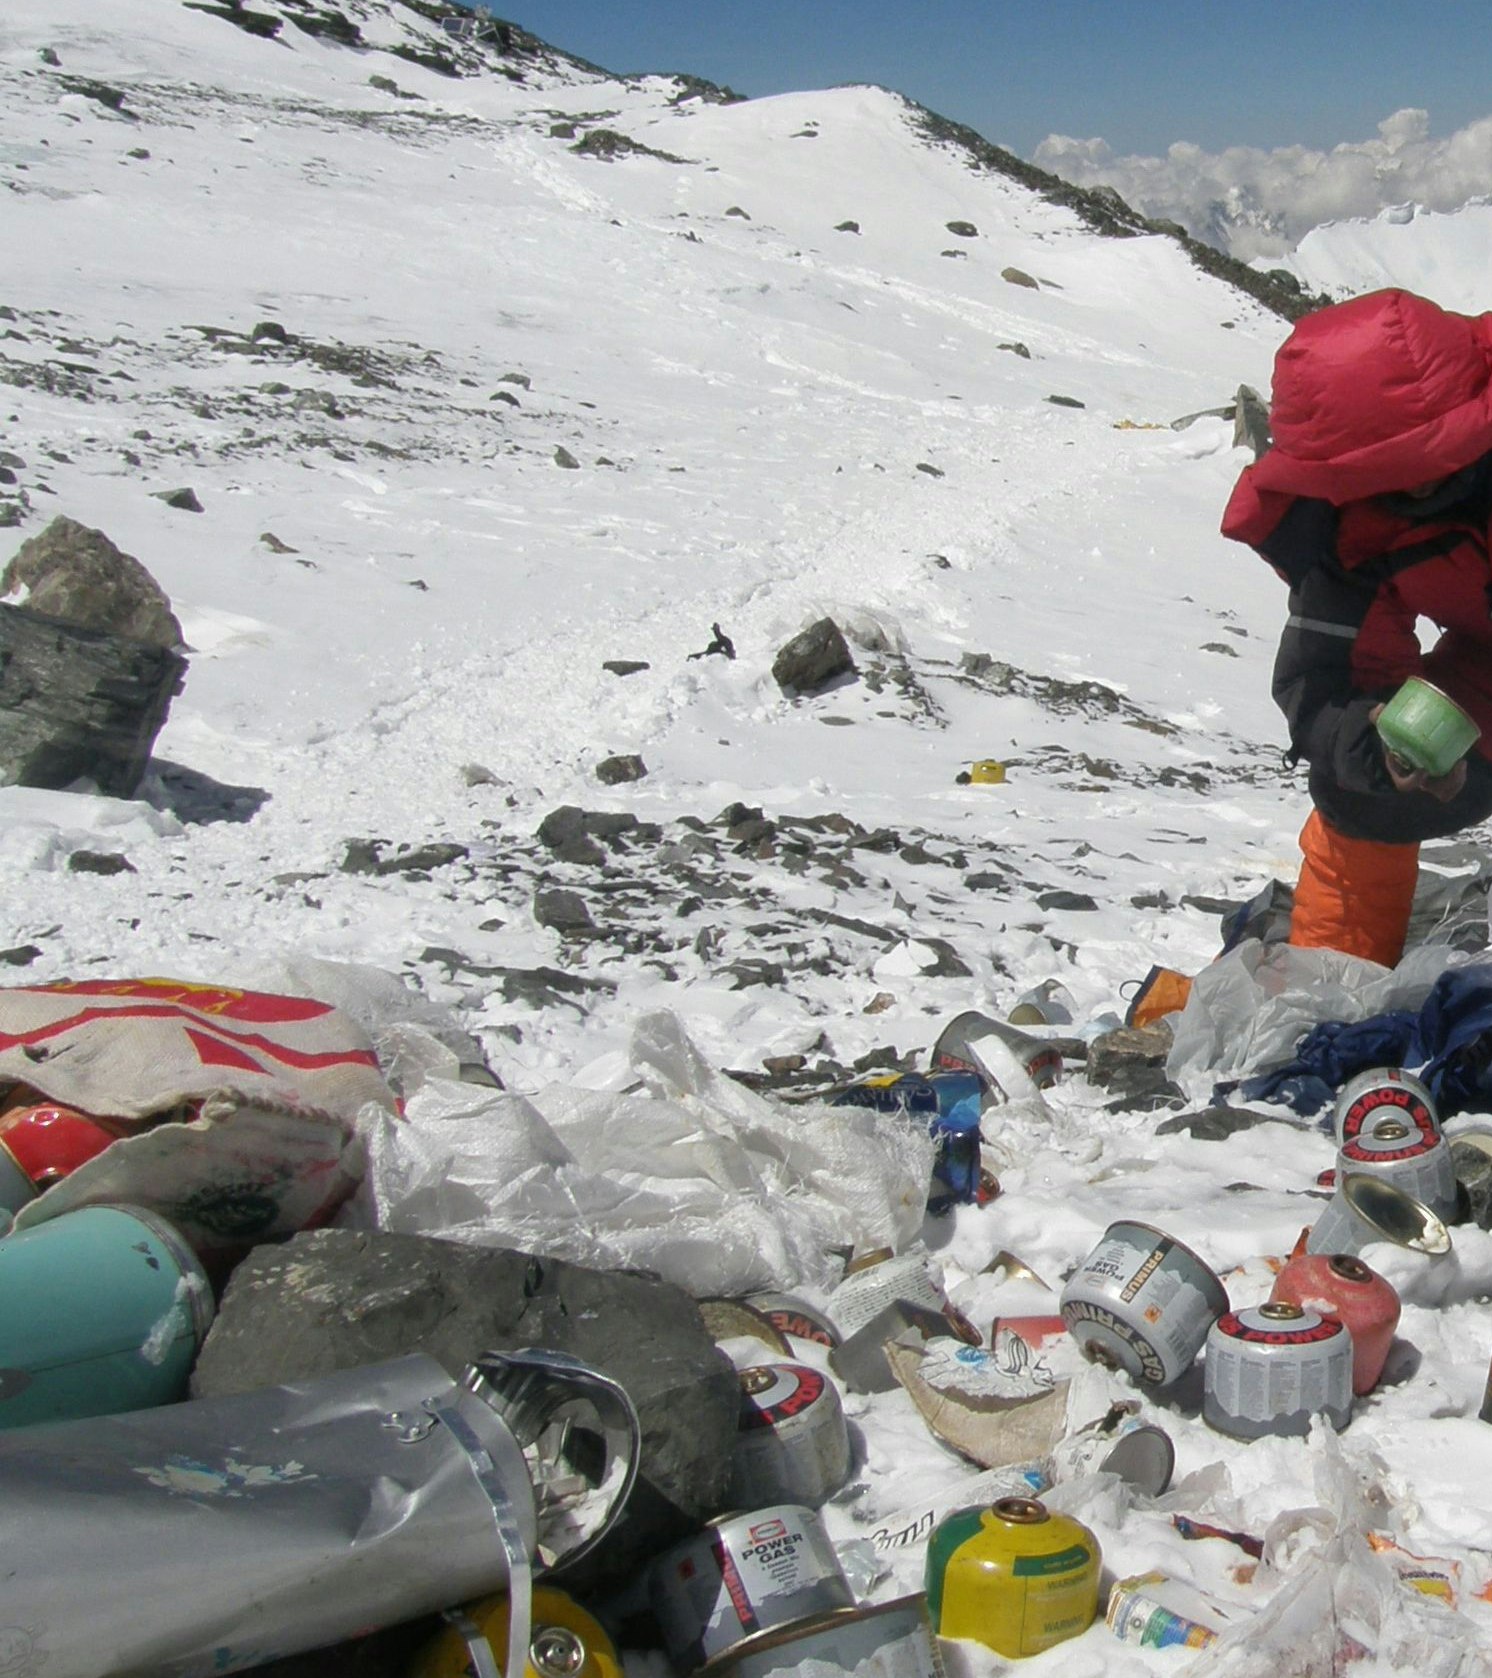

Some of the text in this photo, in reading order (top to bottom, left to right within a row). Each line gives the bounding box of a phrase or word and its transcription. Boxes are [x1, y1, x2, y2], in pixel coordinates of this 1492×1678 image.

[1120, 1250, 1166, 1304] PRIMUS
[1131, 1338, 1166, 1382] GAS
[741, 1532, 804, 1561] POWER
[759, 1545, 797, 1564] GAS
